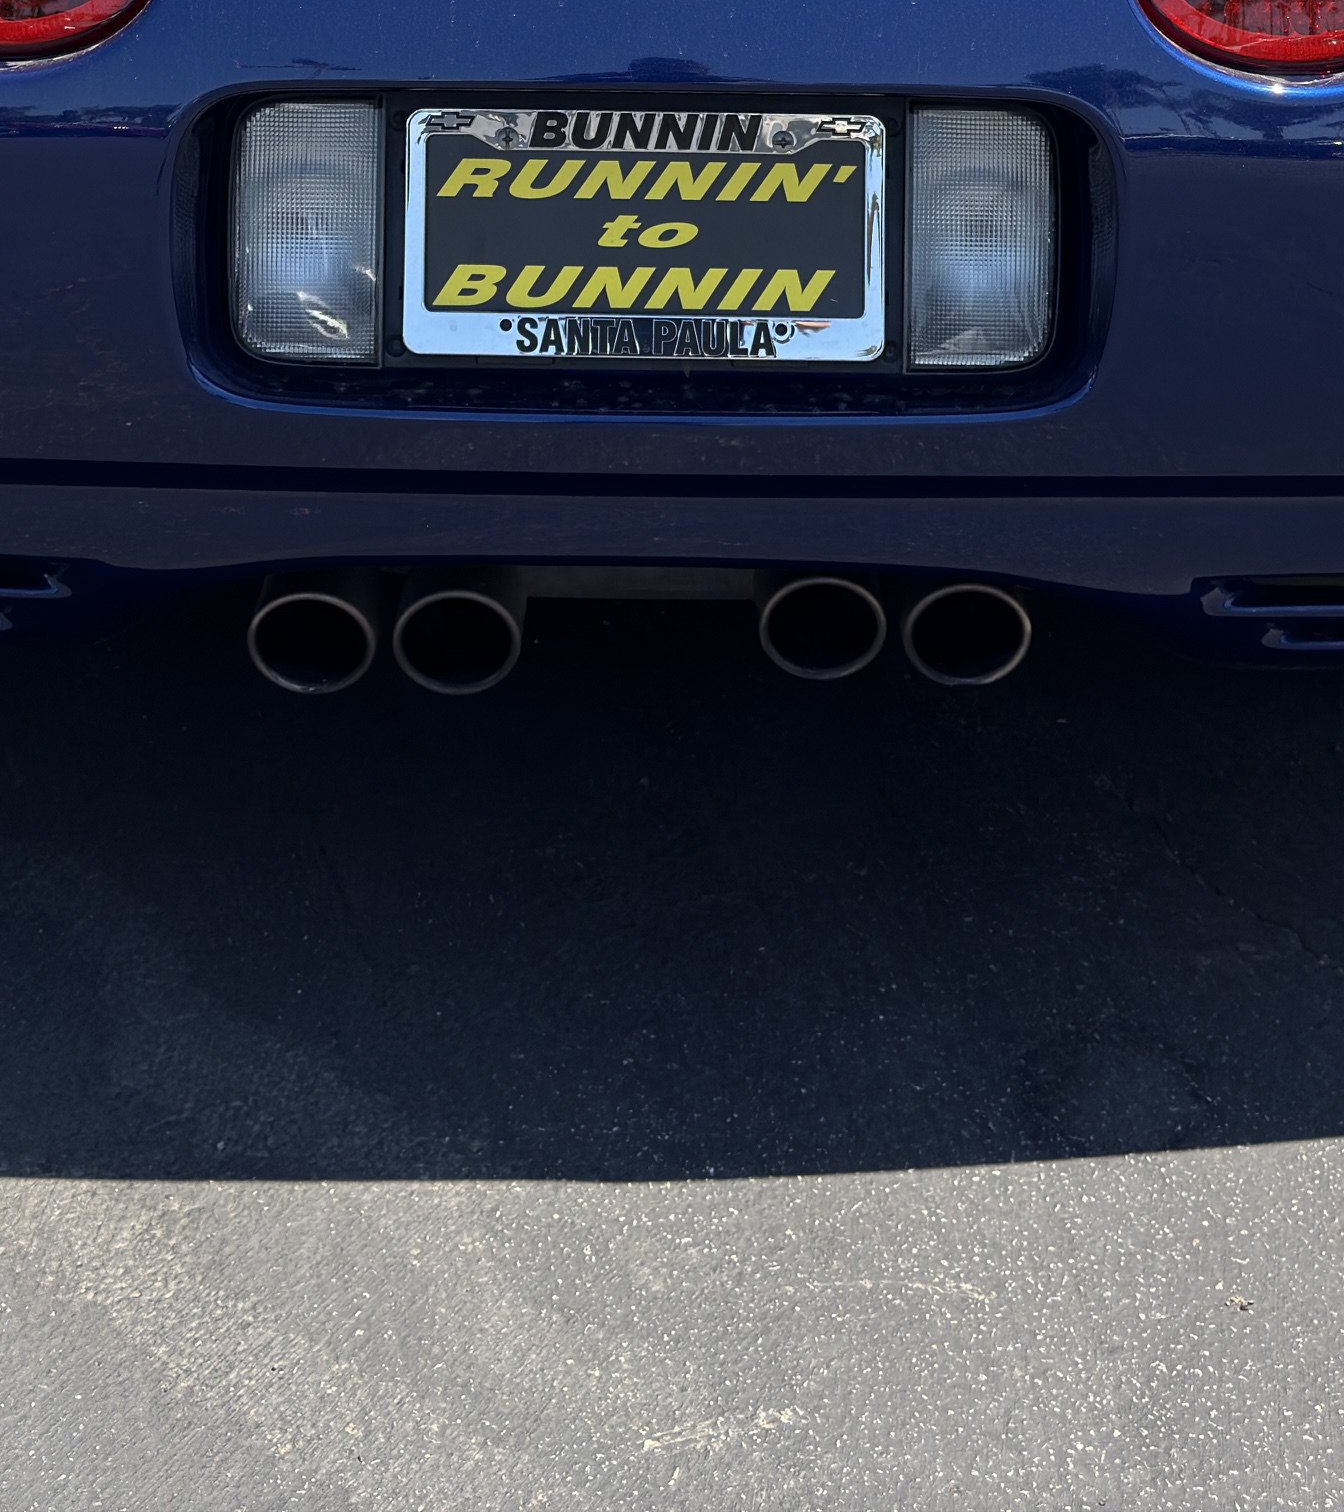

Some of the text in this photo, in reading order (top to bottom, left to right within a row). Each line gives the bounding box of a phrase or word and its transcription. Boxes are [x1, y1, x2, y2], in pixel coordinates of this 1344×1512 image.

[529, 111, 762, 151] BUNNIN
[437, 158, 857, 203] RUNNIN'
[597, 215, 699, 248] to
[432, 263, 836, 313] BUNNIN
[516, 316, 777, 357] SANTA PAULA
